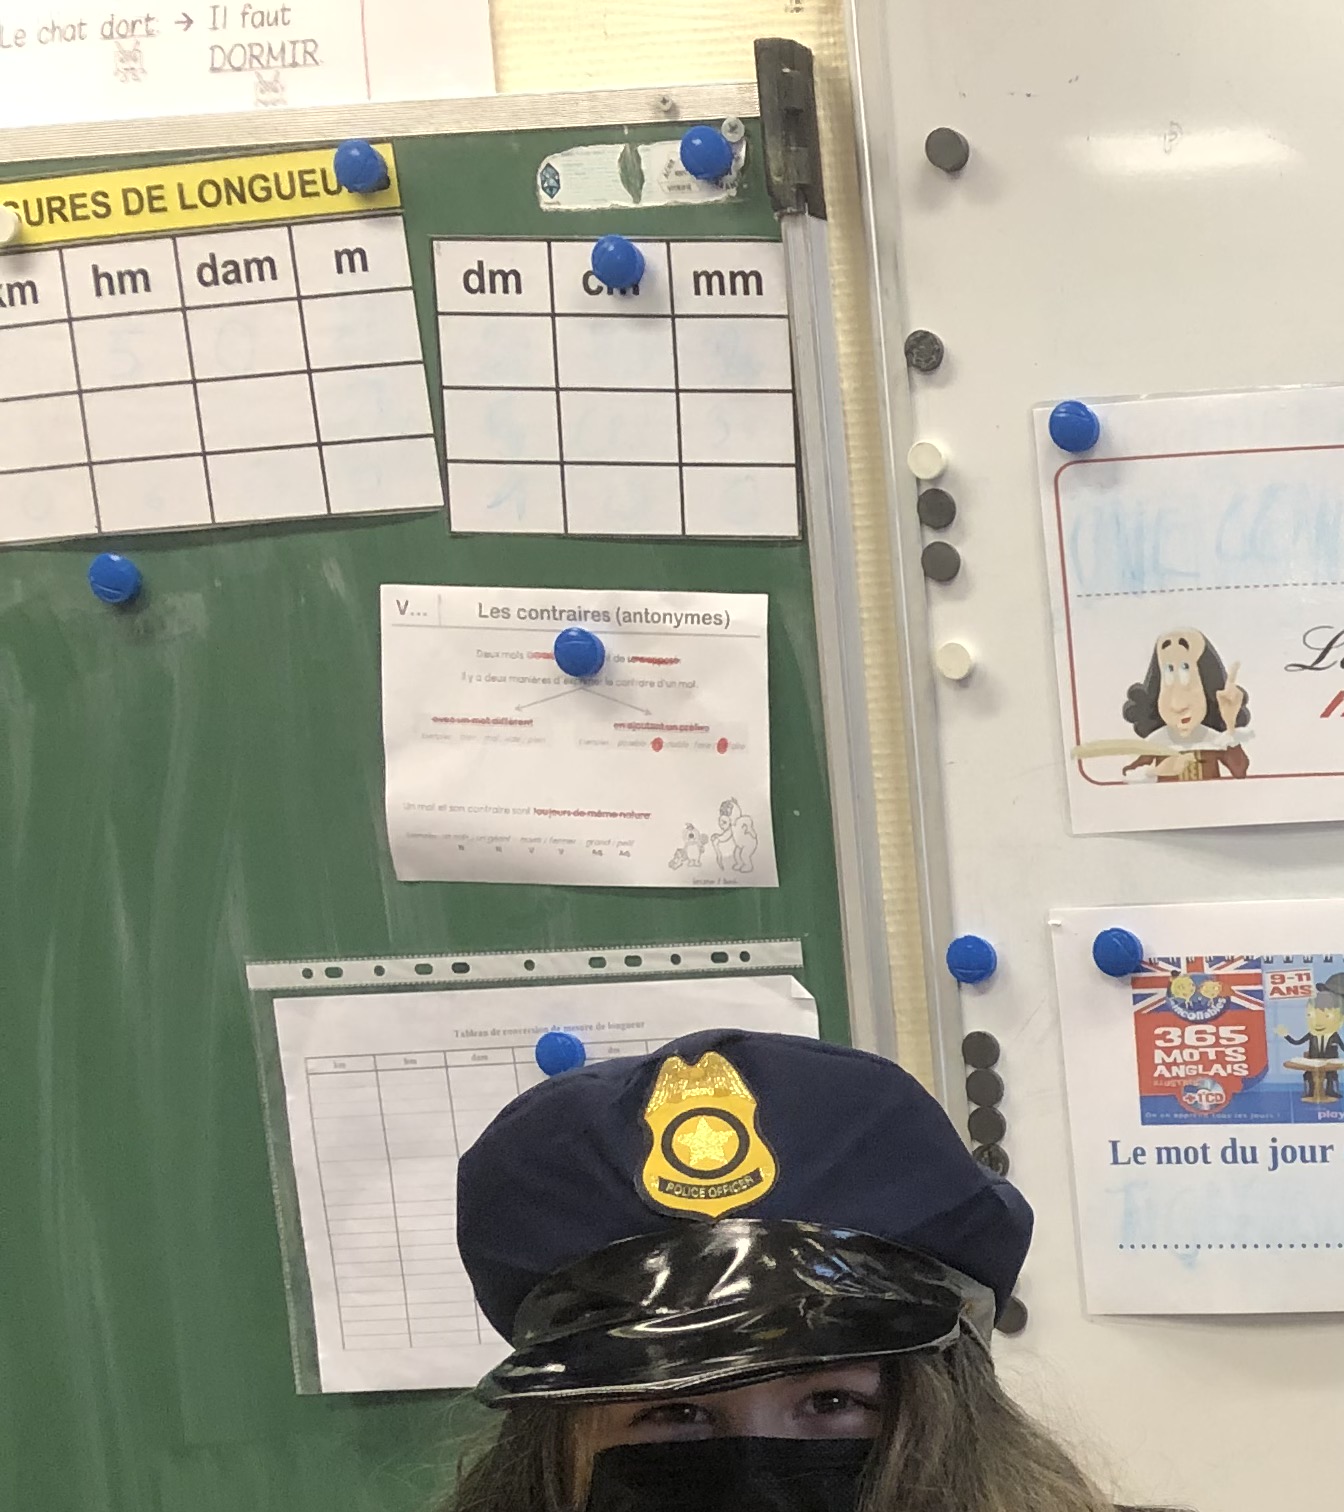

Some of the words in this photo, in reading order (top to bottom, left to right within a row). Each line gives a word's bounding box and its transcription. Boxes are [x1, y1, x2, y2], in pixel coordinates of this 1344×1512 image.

[37, 19, 88, 45] chat
[208, 5, 229, 31] Il
[240, 3, 292, 29] faut
[208, 38, 320, 73] DORMIR
[121, 184, 168, 216] DE
[177, 166, 346, 211] LONGUEU
[91, 264, 152, 298] hm
[196, 252, 278, 287] dam
[334, 245, 370, 275] m
[462, 260, 523, 295] dm
[692, 268, 764, 297] mm
[477, 602, 511, 620] Les
[516, 604, 611, 624] contraires
[615, 606, 731, 630] (antonymes)
[1268, 984, 1313, 997] ANS
[1269, 972, 1312, 985] 9-11
[1153, 1024, 1249, 1047] 365
[1153, 1047, 1247, 1064] MOTS
[1153, 1063, 1249, 1078] ANGLAIS
[1109, 1138, 1150, 1166] Le
[1156, 1141, 1211, 1165] mot
[1220, 1136, 1261, 1165] du
[1267, 1137, 1334, 1172] jour
